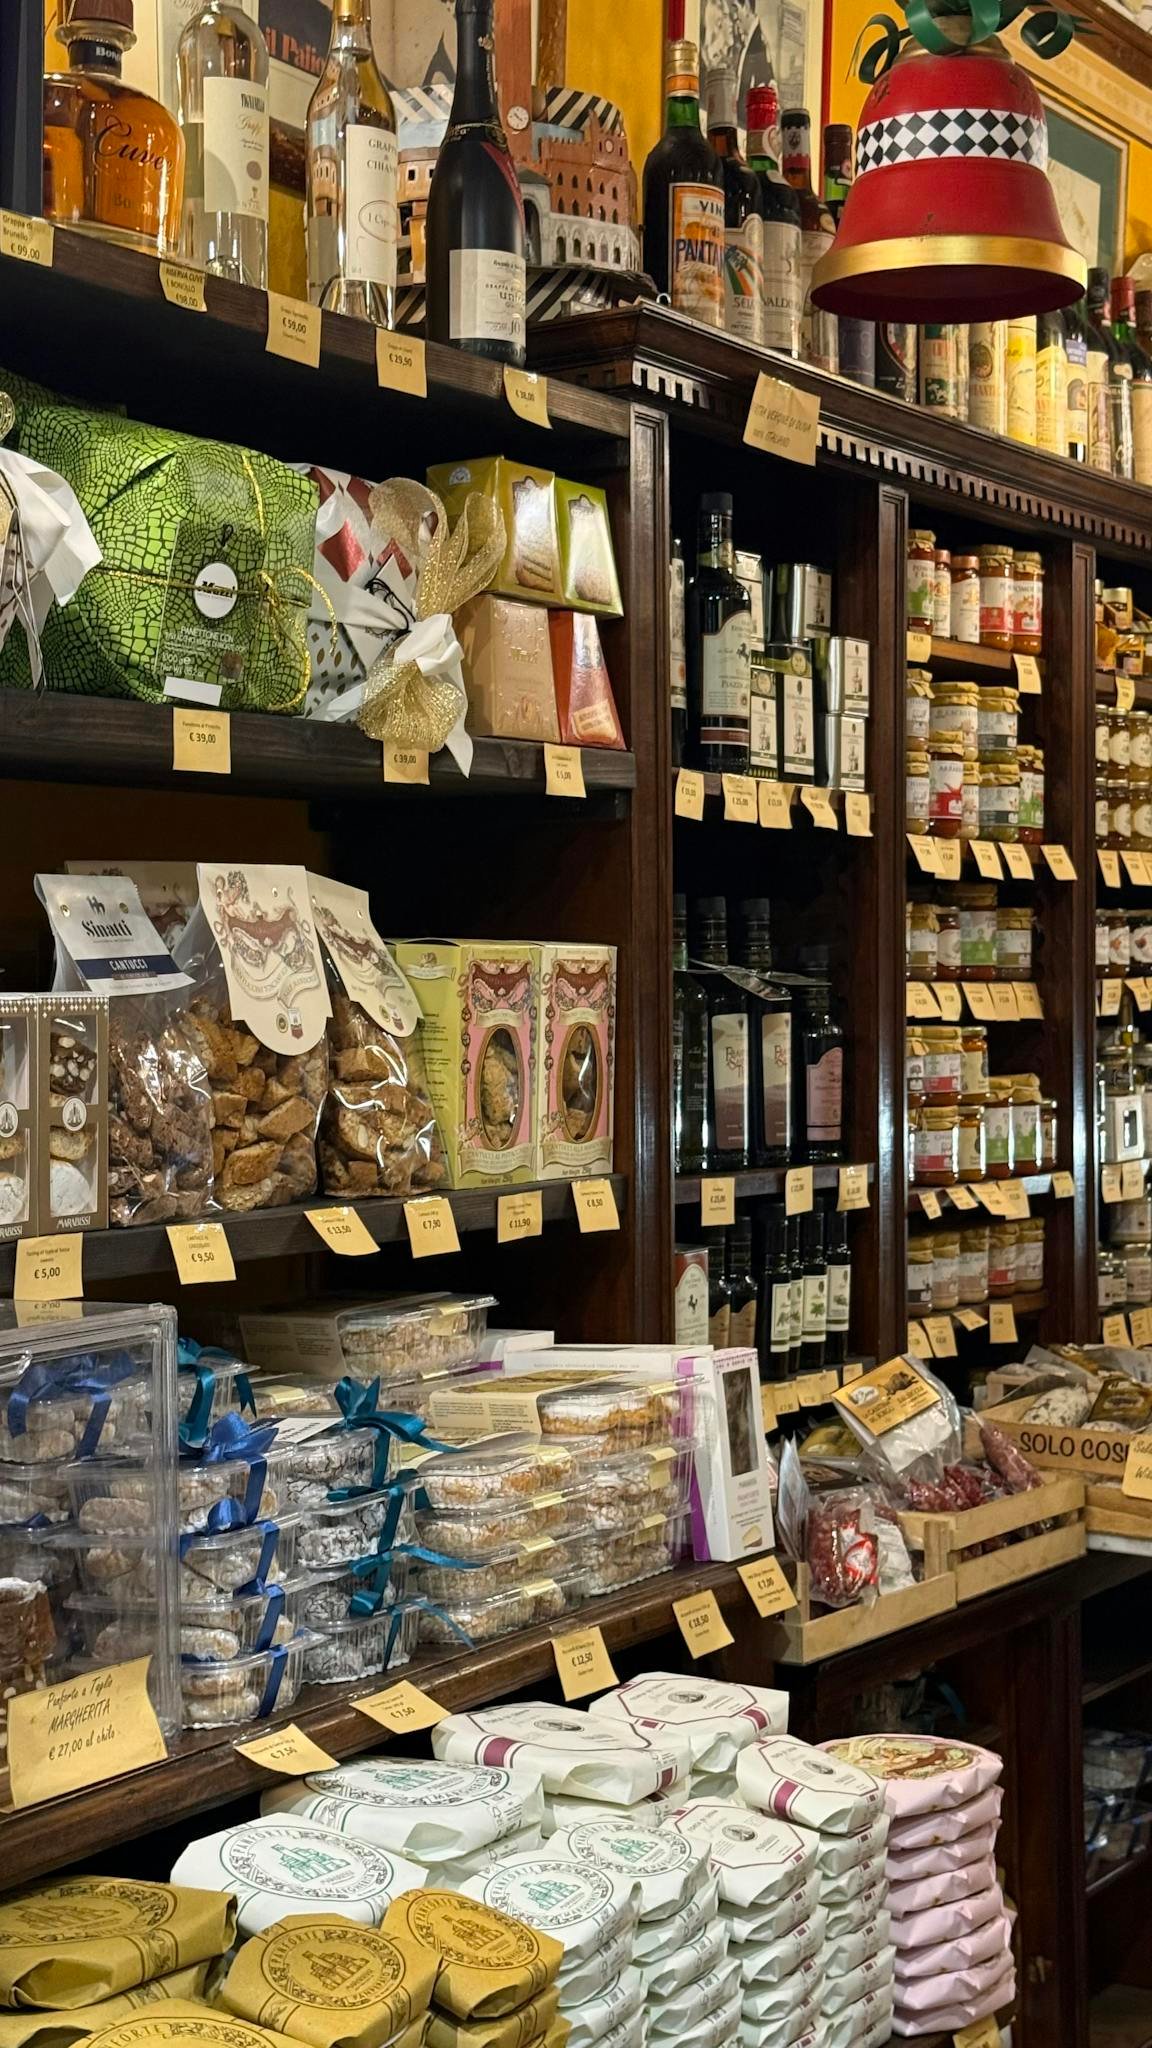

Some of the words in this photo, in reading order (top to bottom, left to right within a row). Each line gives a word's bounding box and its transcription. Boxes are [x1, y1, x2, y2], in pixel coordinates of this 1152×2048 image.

[17, 244, 40, 260] 99,00
[196, 733, 216, 745] 39,00
[399, 755, 417, 765] 39,00
[81, 919, 133, 938] Sinatti
[109, 958, 148, 971] CANTUCCI
[197, 1251, 215, 1263] 9,50
[34, 1269, 40, 1279] €
[41, 1267, 60, 1280] 5,00
[1020, 1431, 1075, 1458] SOLO
[576, 1652, 593, 1666] 12,50
[47, 1689, 79, 1710] Panforte
[90, 1673, 113, 1695] Taglio
[48, 1698, 111, 1735] MARGHERITA
[48, 1746, 55, 1761] €
[57, 1738, 83, 1759] 27,00
[85, 1729, 94, 1749] al
[96, 1723, 116, 1744] chilo
[231, 1828, 291, 1857] PANFORTE
[319, 1871, 376, 1895] MARGHERITA
[492, 1866, 536, 1896] PANFORTE
[271, 1929, 320, 1964] PANFORTE
